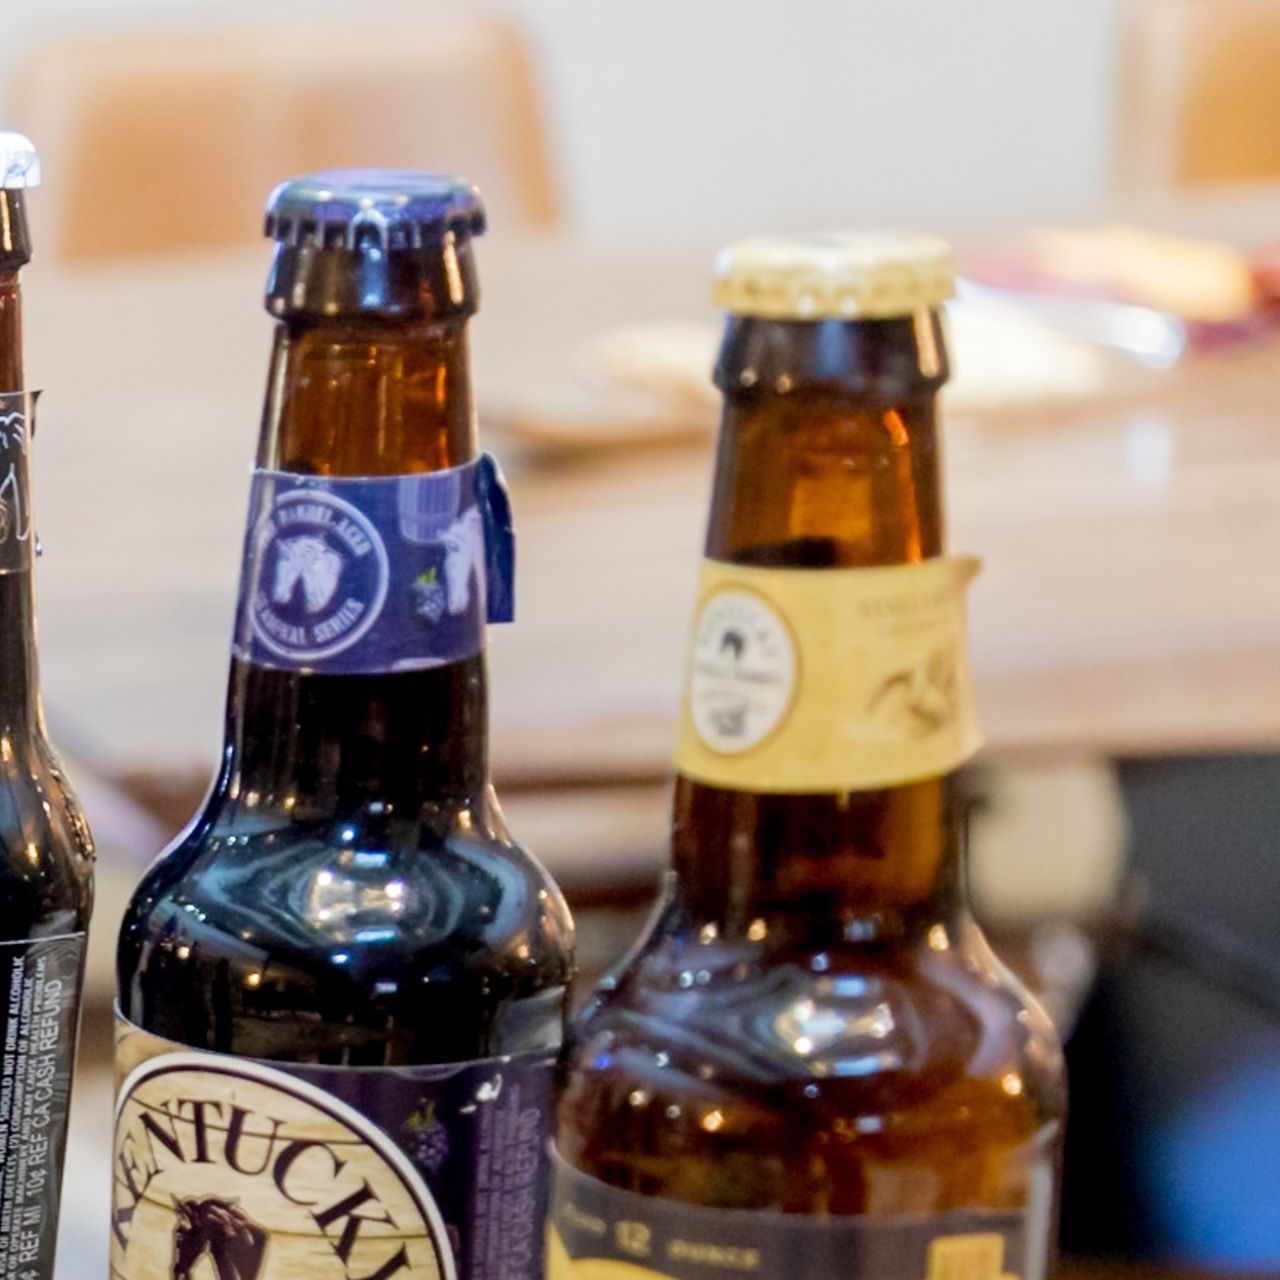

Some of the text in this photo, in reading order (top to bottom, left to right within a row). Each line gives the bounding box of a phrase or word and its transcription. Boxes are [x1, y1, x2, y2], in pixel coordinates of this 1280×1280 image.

[8, 956, 24, 1014] ALCOHOLIC
[21, 977, 33, 1037] ALCOHOLIC
[39, 979, 63, 1051] REFUND
[5, 1017, 18, 1051] DRINK
[19, 1040, 28, 1052] OF
[3, 1054, 14, 1075] NOT
[36, 1053, 56, 1101] CASH
[0, 1077, 13, 1121] SHOULD
[33, 1102, 51, 1128] CA
[29, 1132, 48, 1165] REF
[26, 1168, 48, 1196] 10¢
[23, 1205, 41, 1225] MI
[0, 1235, 10, 1248] OF
[19, 1231, 40, 1262] REF
